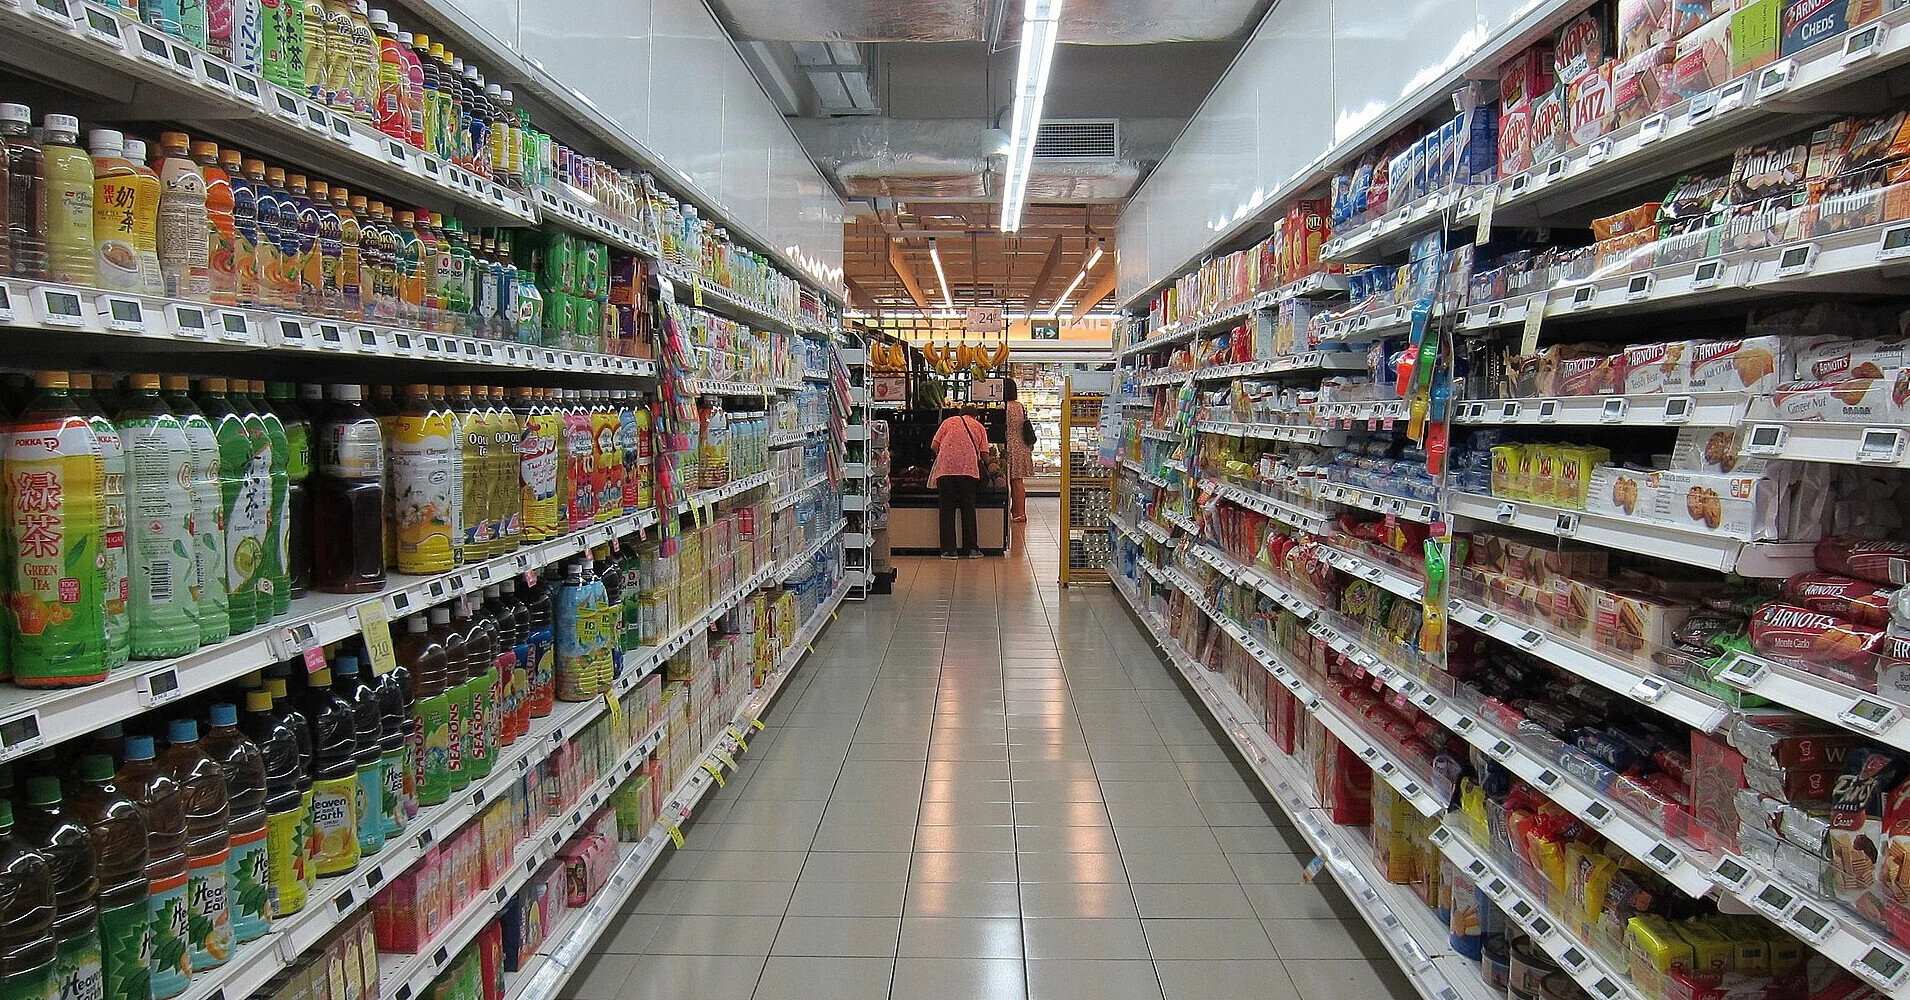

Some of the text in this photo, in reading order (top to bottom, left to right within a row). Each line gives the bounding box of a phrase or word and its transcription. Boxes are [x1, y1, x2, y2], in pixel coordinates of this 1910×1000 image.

[1801, 14, 1837, 41] CHEDS
[1572, 88, 1606, 134] JATZ
[1391, 156, 1410, 191] OREO
[114, 185, 136, 234] 奶茶
[1306, 216, 1321, 229] RITZ
[1787, 396, 1827, 416] Ginger Nut
[23, 563, 58, 576] GREEN
[31, 578, 51, 591] TEA
[1774, 637, 1810, 649] Monte Carlo
[450, 703, 462, 771] SEASONS
[473, 692, 485, 760] SEASONS
[313, 811, 344, 824] Earth
